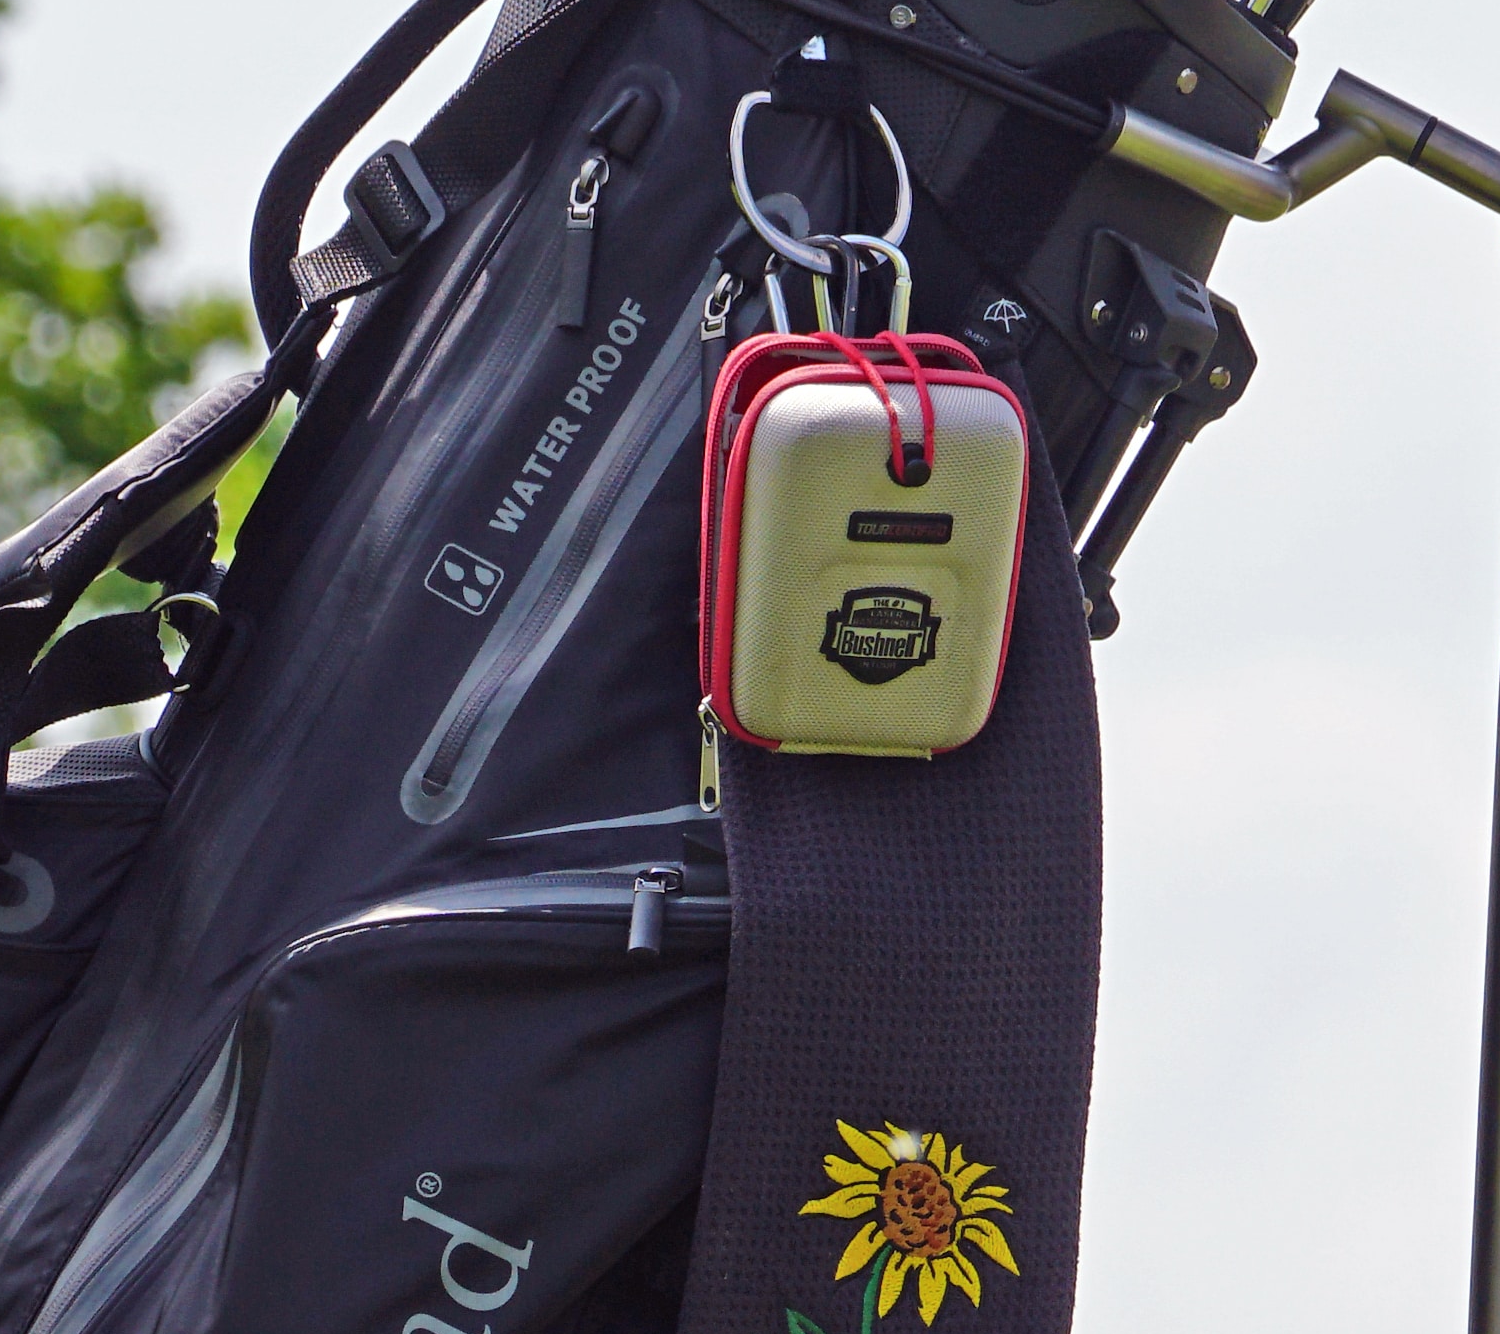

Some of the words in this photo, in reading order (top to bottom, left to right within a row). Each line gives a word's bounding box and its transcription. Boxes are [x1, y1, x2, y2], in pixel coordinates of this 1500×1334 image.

[488, 416, 582, 534] WATER
[564, 297, 647, 415] PROOF
[873, 599, 889, 607] THE
[840, 630, 922, 658] Bushnell
